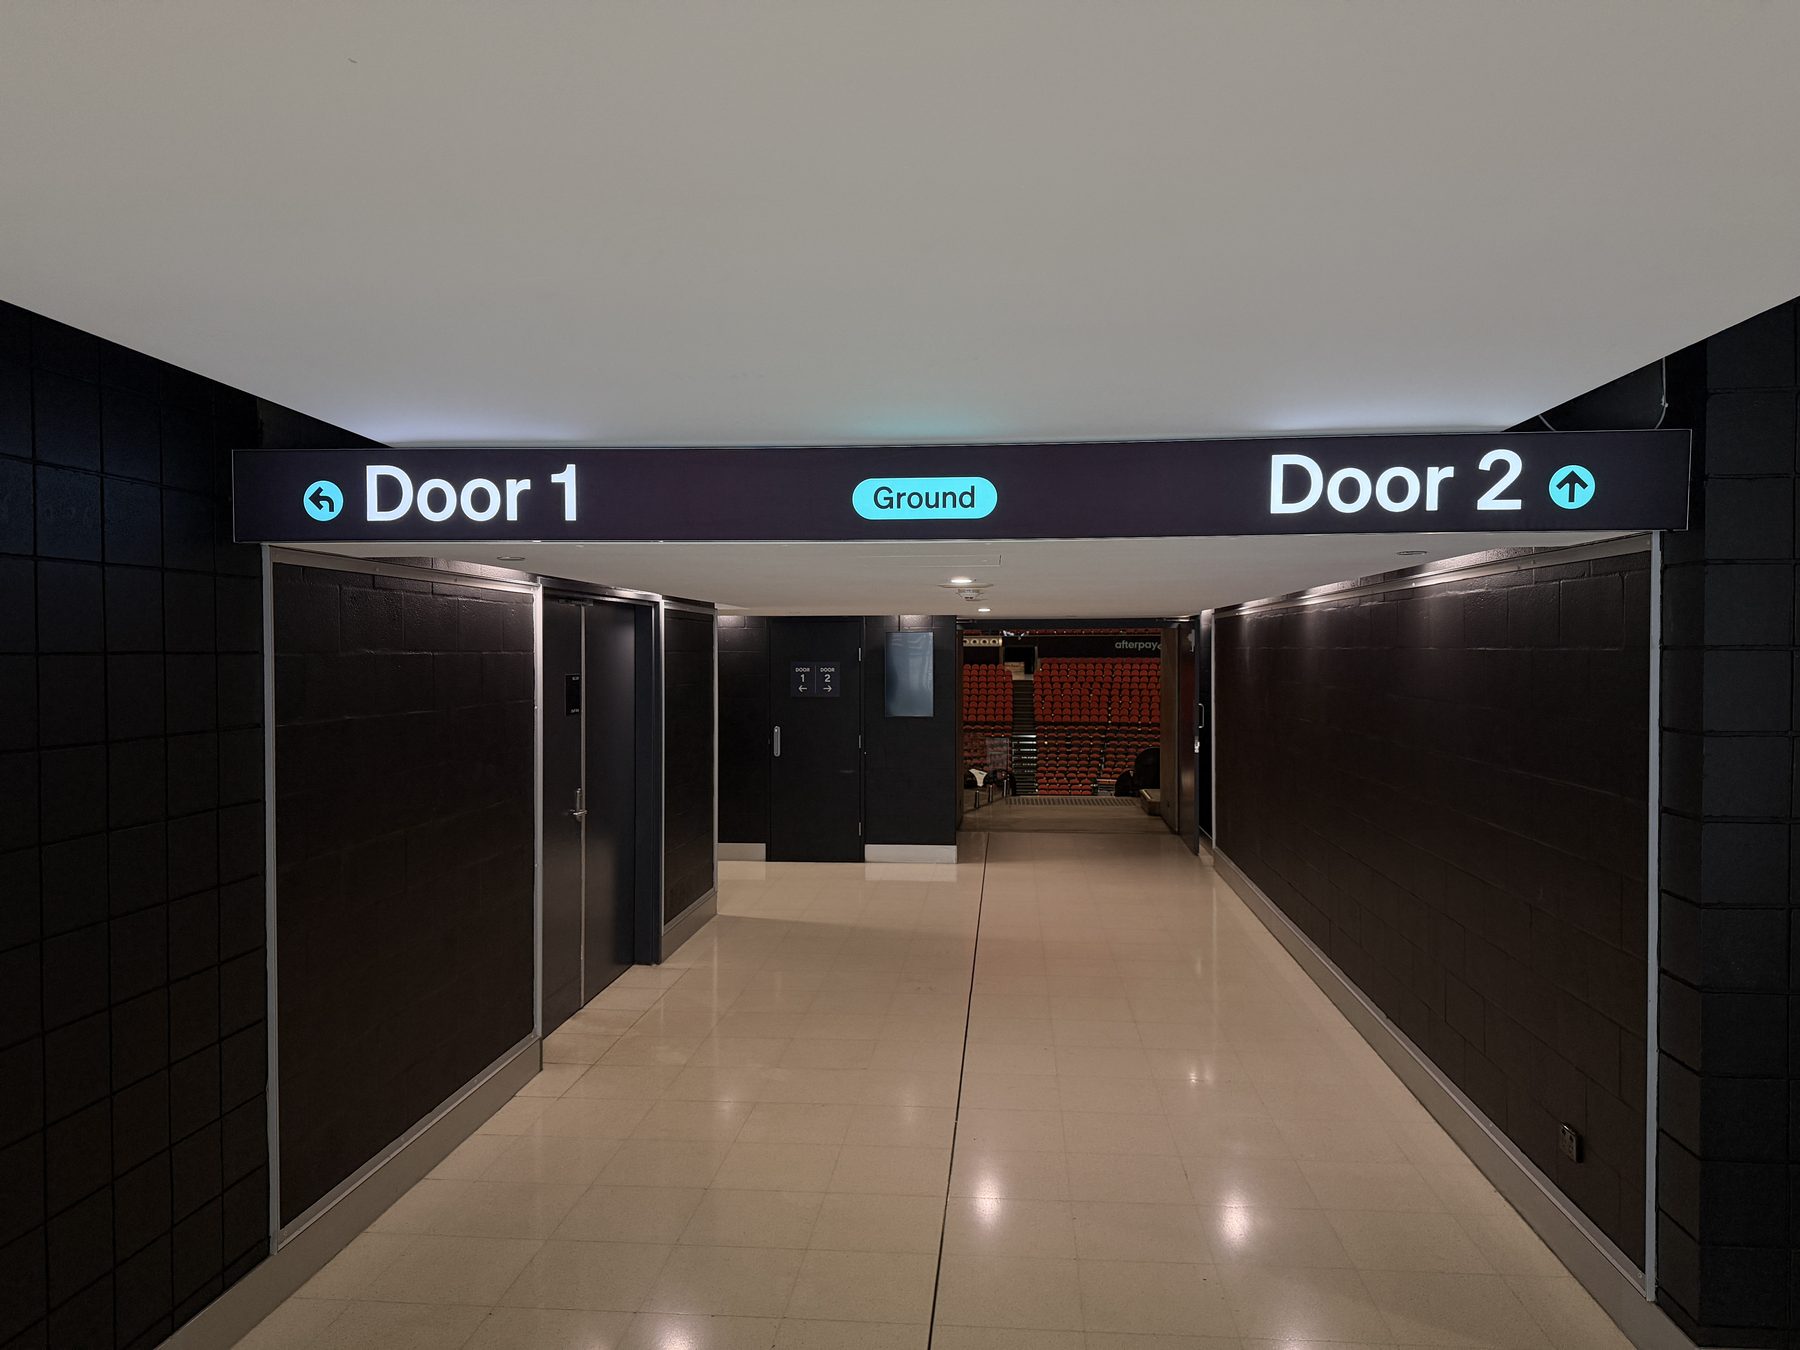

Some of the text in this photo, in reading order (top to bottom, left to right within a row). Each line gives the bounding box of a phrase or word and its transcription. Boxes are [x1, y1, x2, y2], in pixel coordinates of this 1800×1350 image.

[1269, 448, 1523, 515] Door 2
[366, 463, 577, 522] Door 1
[873, 485, 975, 510] Ground
[1114, 640, 1158, 651] afterpay
[800, 673, 805, 683] 1
[824, 673, 831, 683] 2
